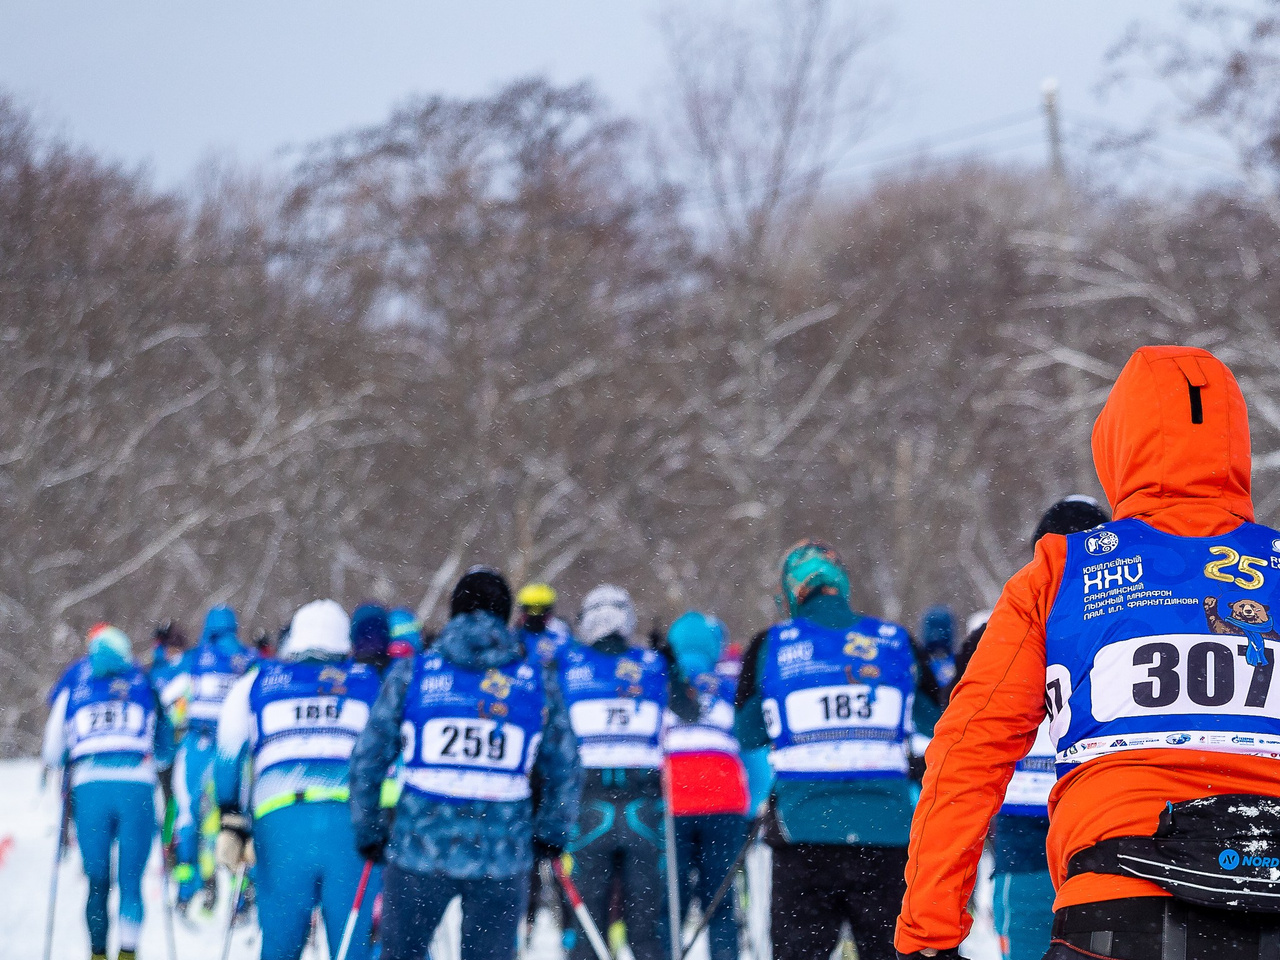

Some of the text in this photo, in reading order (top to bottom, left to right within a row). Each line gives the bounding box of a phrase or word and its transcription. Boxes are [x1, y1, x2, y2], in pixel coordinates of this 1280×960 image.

[1083, 555, 1142, 574] ЮБИЛЕЙНЫЙ
[1204, 545, 1269, 590] 25
[1083, 590, 1172, 612] ЛЫЖНЫЙ МАРАФОН
[1132, 641, 1275, 708] 307
[820, 693, 873, 721] 183
[441, 724, 506, 760] 259
